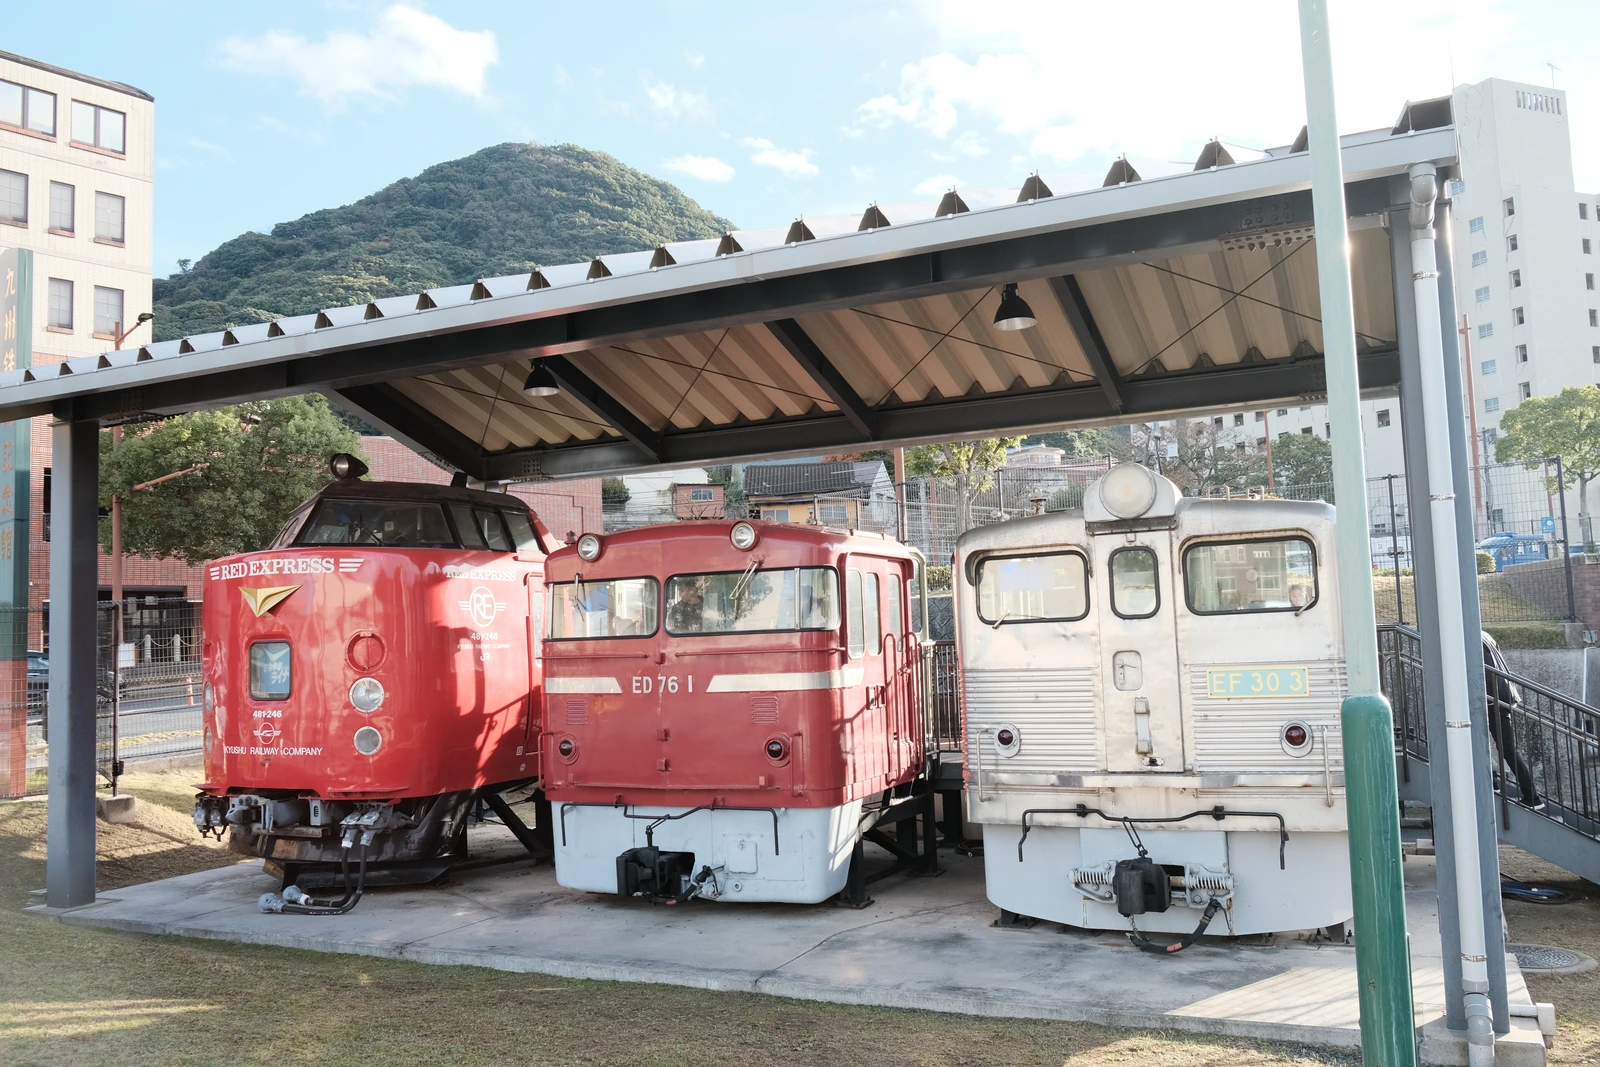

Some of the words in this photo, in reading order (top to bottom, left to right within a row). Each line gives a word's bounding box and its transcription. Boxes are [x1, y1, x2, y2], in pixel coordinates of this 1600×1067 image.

[221, 562, 248, 580] RED
[249, 558, 335, 576] EXPRESS
[446, 568, 469, 579] RED
[470, 569, 516, 581] EXPRESS
[473, 593, 494, 620] RE
[480, 652, 490, 662] JR
[632, 676, 652, 694] ED
[657, 675, 679, 694] 76
[1212, 673, 1243, 693] EF
[1250, 671, 1280, 693] 30
[1289, 671, 1303, 692] 3
[224, 745, 247, 755] KYUSHU
[250, 746, 279, 756] RAILWAY
[283, 747, 323, 756] COMPANY
